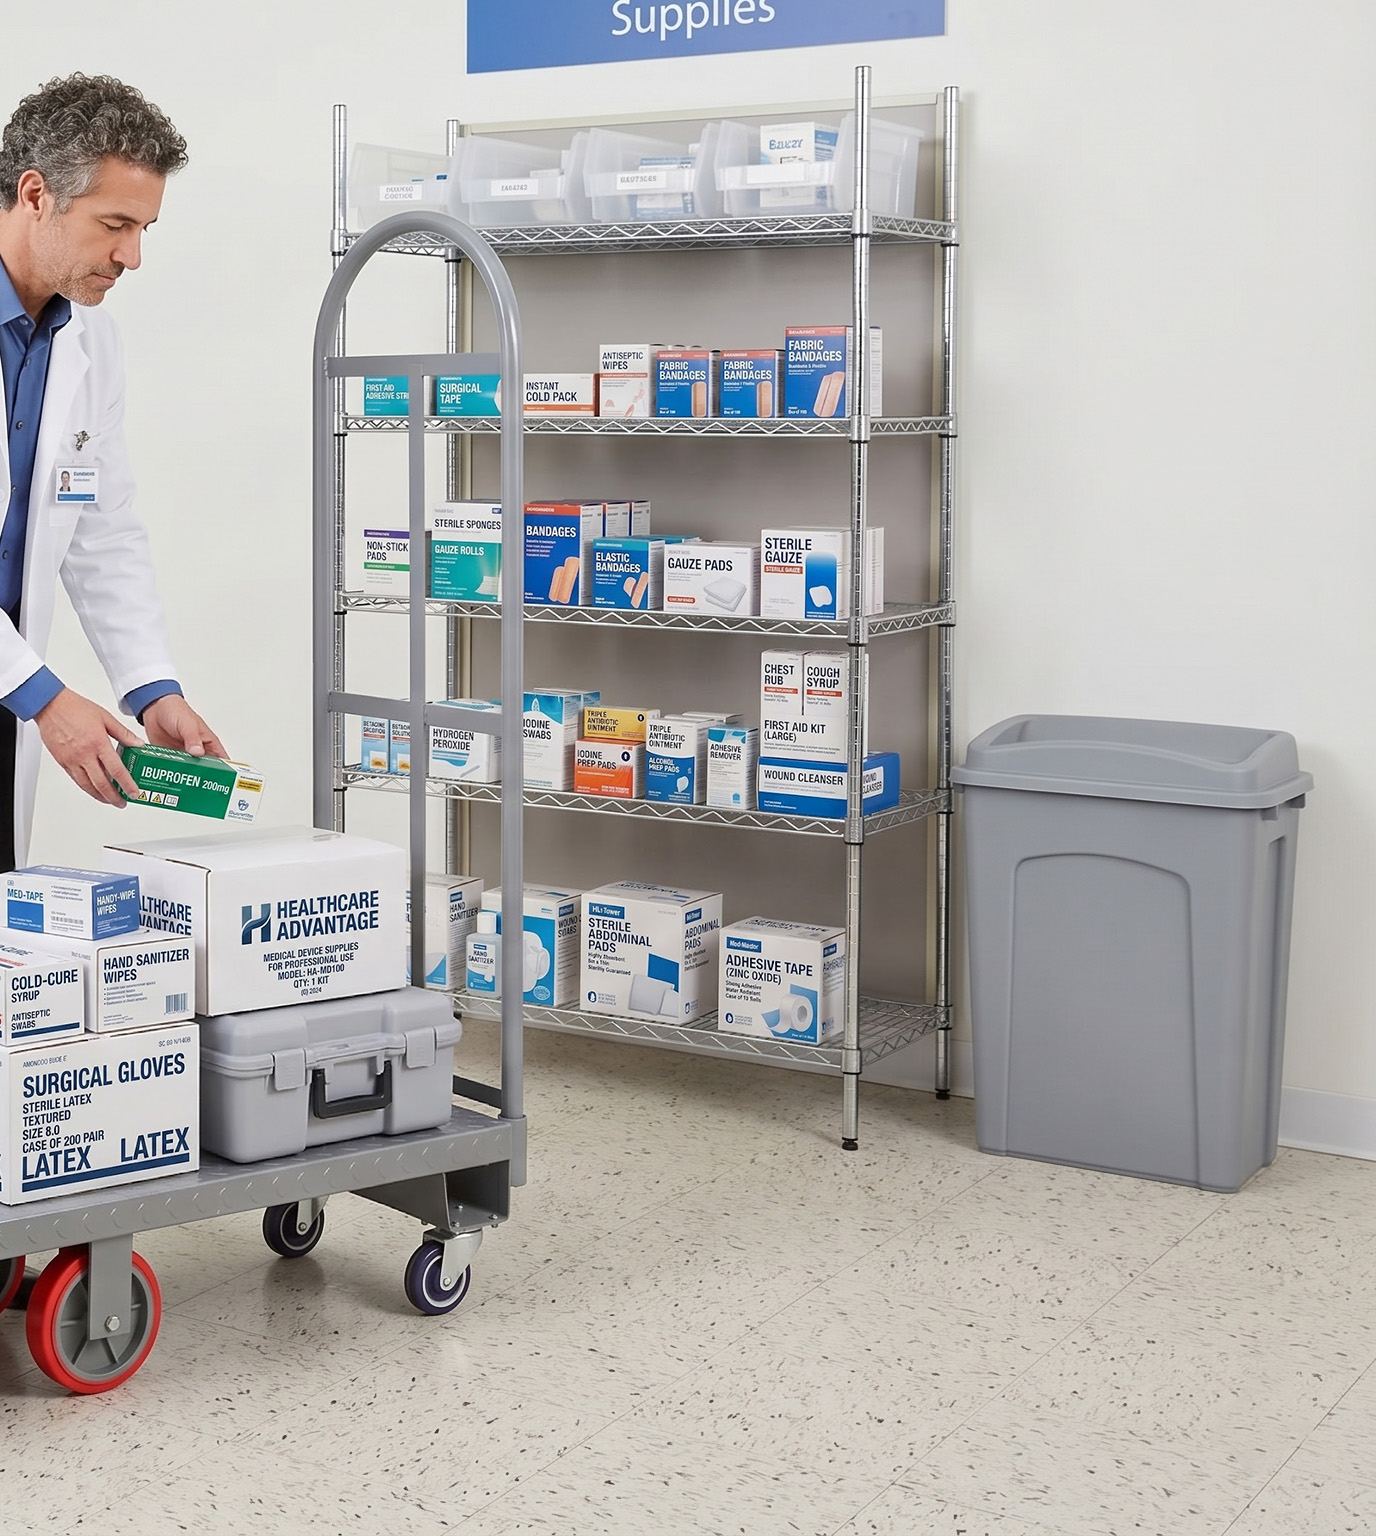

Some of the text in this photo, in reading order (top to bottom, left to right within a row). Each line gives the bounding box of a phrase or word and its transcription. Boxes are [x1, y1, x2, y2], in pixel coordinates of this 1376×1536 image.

[611, 0, 775, 41] Supplies
[788, 340, 824, 351] FABRIC
[602, 351, 643, 360] ANTISEPTIC
[788, 350, 842, 361] BANDAGES
[602, 360, 628, 370] WIPES
[659, 361, 689, 371] FABRIC
[659, 370, 706, 381] BANDAGES
[365, 383, 395, 392] FIRST AID
[439, 382, 482, 394] SURGICAL
[526, 381, 560, 391] INSTANT
[365, 391, 409, 400] ADHESIVE STR
[440, 394, 461, 404] TAPE
[526, 391, 577, 402] COLD PACK
[434, 518, 501, 530] STERILE SPONGES
[526, 525, 576, 538] BANDAGES
[366, 541, 408, 552] NON-STICK
[435, 544, 485, 556] GAUZE ROLLS
[765, 537, 812, 550] STERILE
[366, 551, 387, 561] PADS
[596, 552, 630, 563] ELASTIC
[765, 550, 802, 564] GAUZE
[596, 562, 641, 573] BANDAGES
[667, 557, 733, 571] GAUZE PADS
[764, 663, 795, 675] CHEST
[807, 667, 840, 678] COUGH
[764, 675, 784, 685] RUB
[807, 678, 840, 689] SYRUP
[523, 719, 550, 729] IODINE
[649, 724, 671, 733] TRIPLE
[764, 719, 826, 734] FIRST AID KIT
[432, 728, 474, 741] HYDROGEN
[523, 729, 552, 740] SWABS
[649, 732, 686, 742] ANTIBIOTIC
[764, 730, 797, 743] (LARGE)
[432, 740, 471, 751] PEROXIDE
[649, 740, 682, 749] OINTMENT
[710, 743, 742, 753] ADHESIVE
[710, 751, 742, 761] REMOVER
[577, 759, 617, 770] PREP PADS
[141, 766, 230, 795] IBUPROFEN 200mg
[764, 769, 844, 786] WOUND CLEANSER
[7, 888, 44, 901] MED-TAPE
[97, 889, 136, 906] HANDY-WIPE
[97, 904, 117, 916] WIPES
[139, 895, 192, 922] LTHCARE
[277, 890, 379, 919] HEALTHCARE
[277, 910, 379, 941] ADVANTAGE
[588, 917, 631, 932] STERILE
[684, 919, 720, 939] ABDOMINAL
[588, 929, 652, 947] ABDOMINAL
[684, 937, 701, 951] PADS
[263, 941, 359, 962] MEDICAL DEVICE SUPPLIES
[588, 940, 616, 953] PADS
[104, 948, 189, 970] HAND SANITIZER
[268, 952, 354, 971] FOR PROFESSIONAL USE
[726, 954, 781, 972] ADHESIVE
[784, 961, 813, 977] TAPE
[104, 968, 137, 984] WIPES
[278, 963, 345, 980] MODEL: HA-MD100
[726, 967, 782, 985] (ZINC OXIDE)
[11, 968, 78, 991] COLD-CURE
[293, 979, 310, 989] QTY:
[317, 975, 329, 985] KIT
[11, 990, 40, 1003] SYRUP
[11, 1008, 51, 1022] ANTISEPTIC
[11, 1020, 36, 1031] SWABS
[23, 1052, 185, 1098] SURGICAL GLOVES
[23, 1093, 92, 1114] STERILE LATEX
[23, 1109, 71, 1127] TEXTURED
[23, 1124, 60, 1141] SIZE 8.0
[23, 1129, 105, 1154] CASE OF 200 PAIR
[22, 1127, 189, 1181] LATEX LATEX
